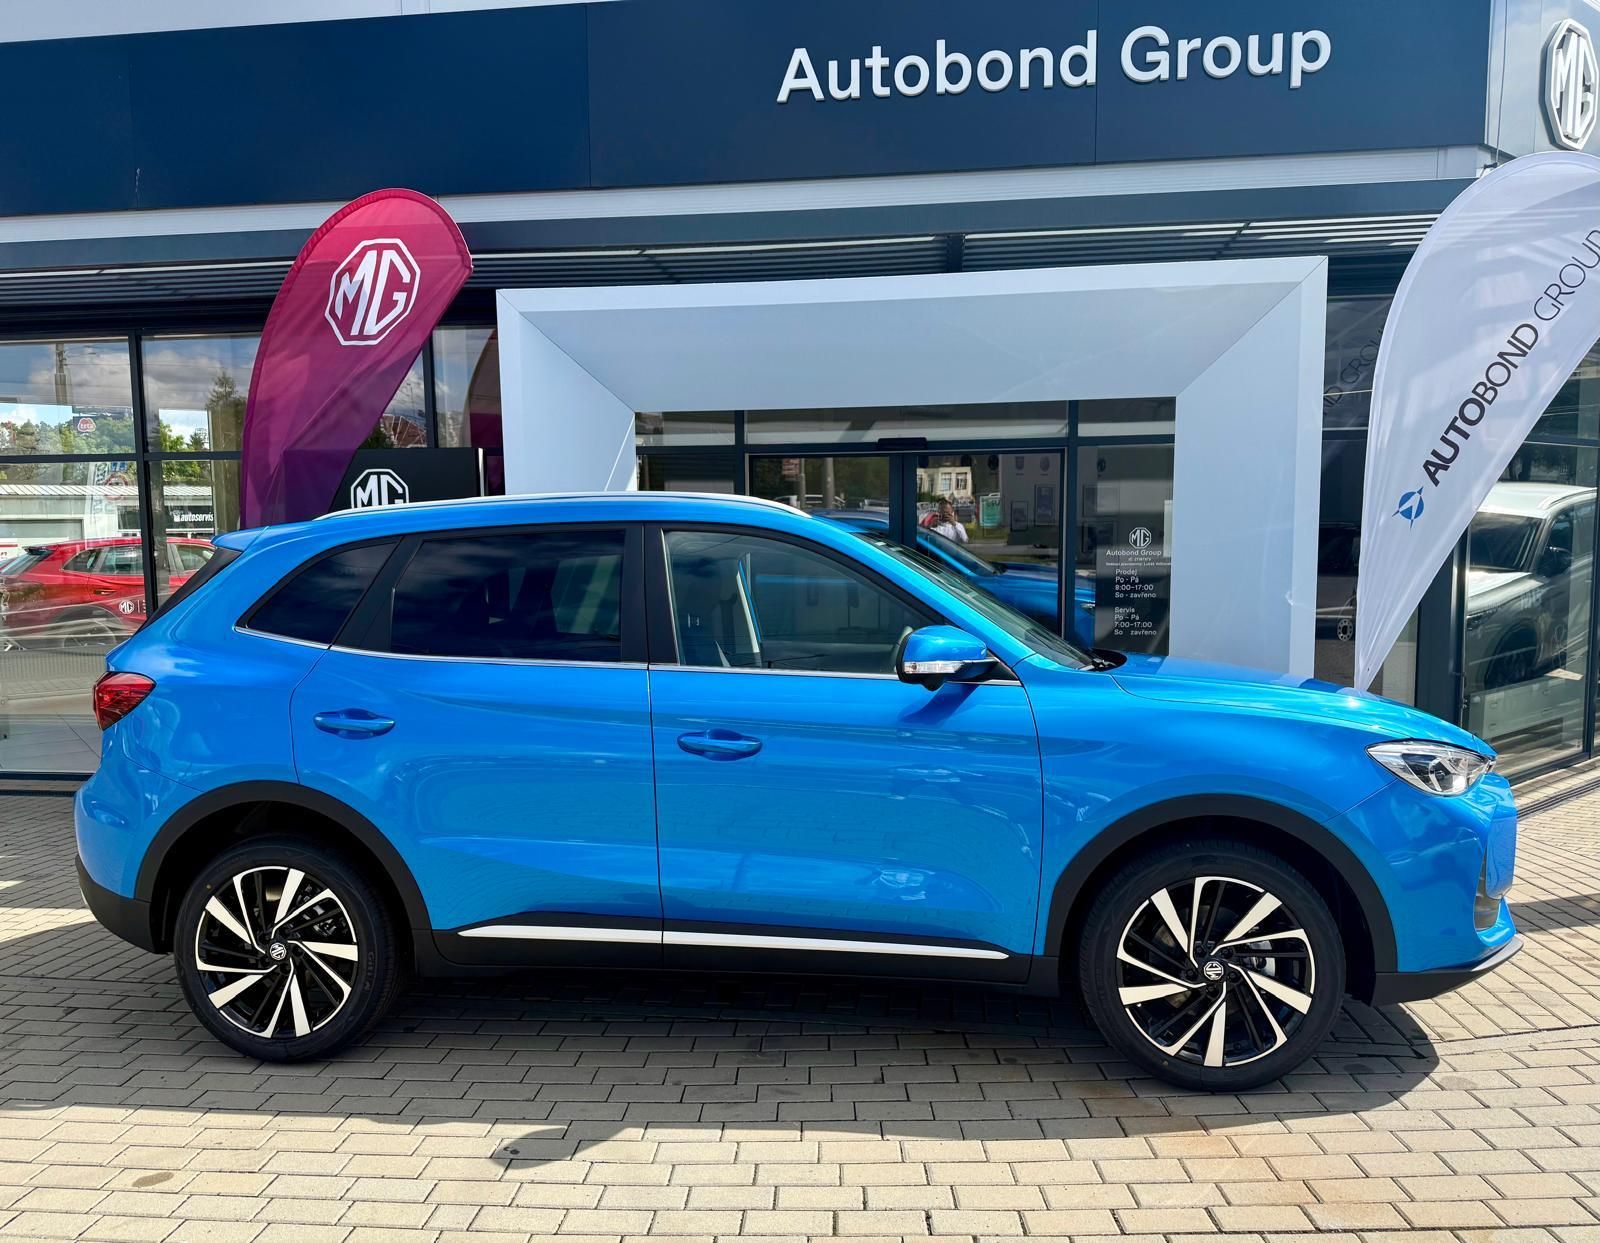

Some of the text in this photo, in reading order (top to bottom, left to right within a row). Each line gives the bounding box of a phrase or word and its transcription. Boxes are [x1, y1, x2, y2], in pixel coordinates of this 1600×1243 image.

[777, 25, 1332, 103] Autobond Group
[1553, 28, 1595, 141] MG
[333, 247, 412, 337] MG
[1422, 323, 1539, 487] AUTOBOND
[354, 473, 406, 507] MG
[181, 512, 214, 521] autoservis
[1130, 528, 1150, 547] MG
[1140, 549, 1161, 557] Group
[1115, 568, 1137, 576] Prodej
[119, 600, 134, 613] MG
